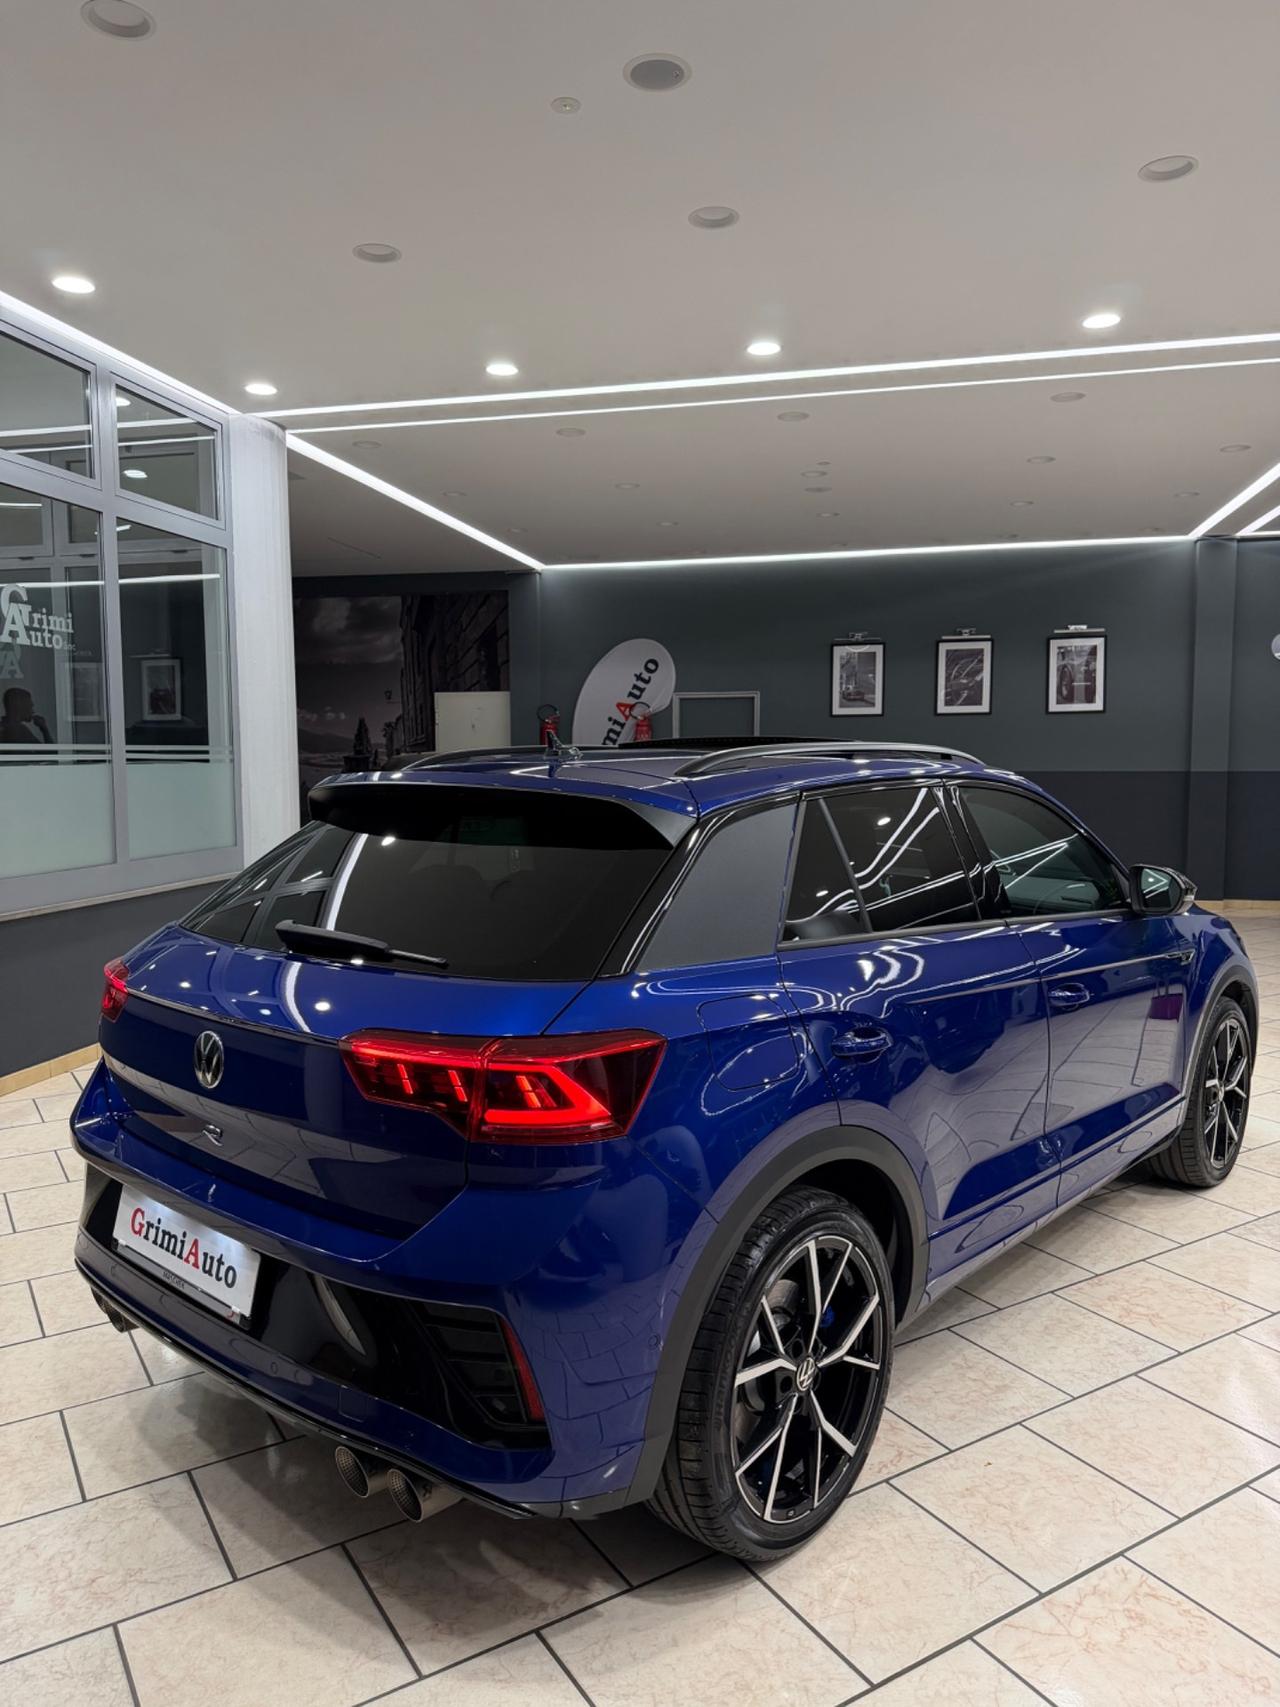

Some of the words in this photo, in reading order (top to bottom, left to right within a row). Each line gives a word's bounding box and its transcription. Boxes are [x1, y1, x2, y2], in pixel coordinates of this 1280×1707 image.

[0, 603, 63, 649] Auto
[602, 658, 659, 745] miAuto
[130, 1207, 237, 1288] GrimiAuto
